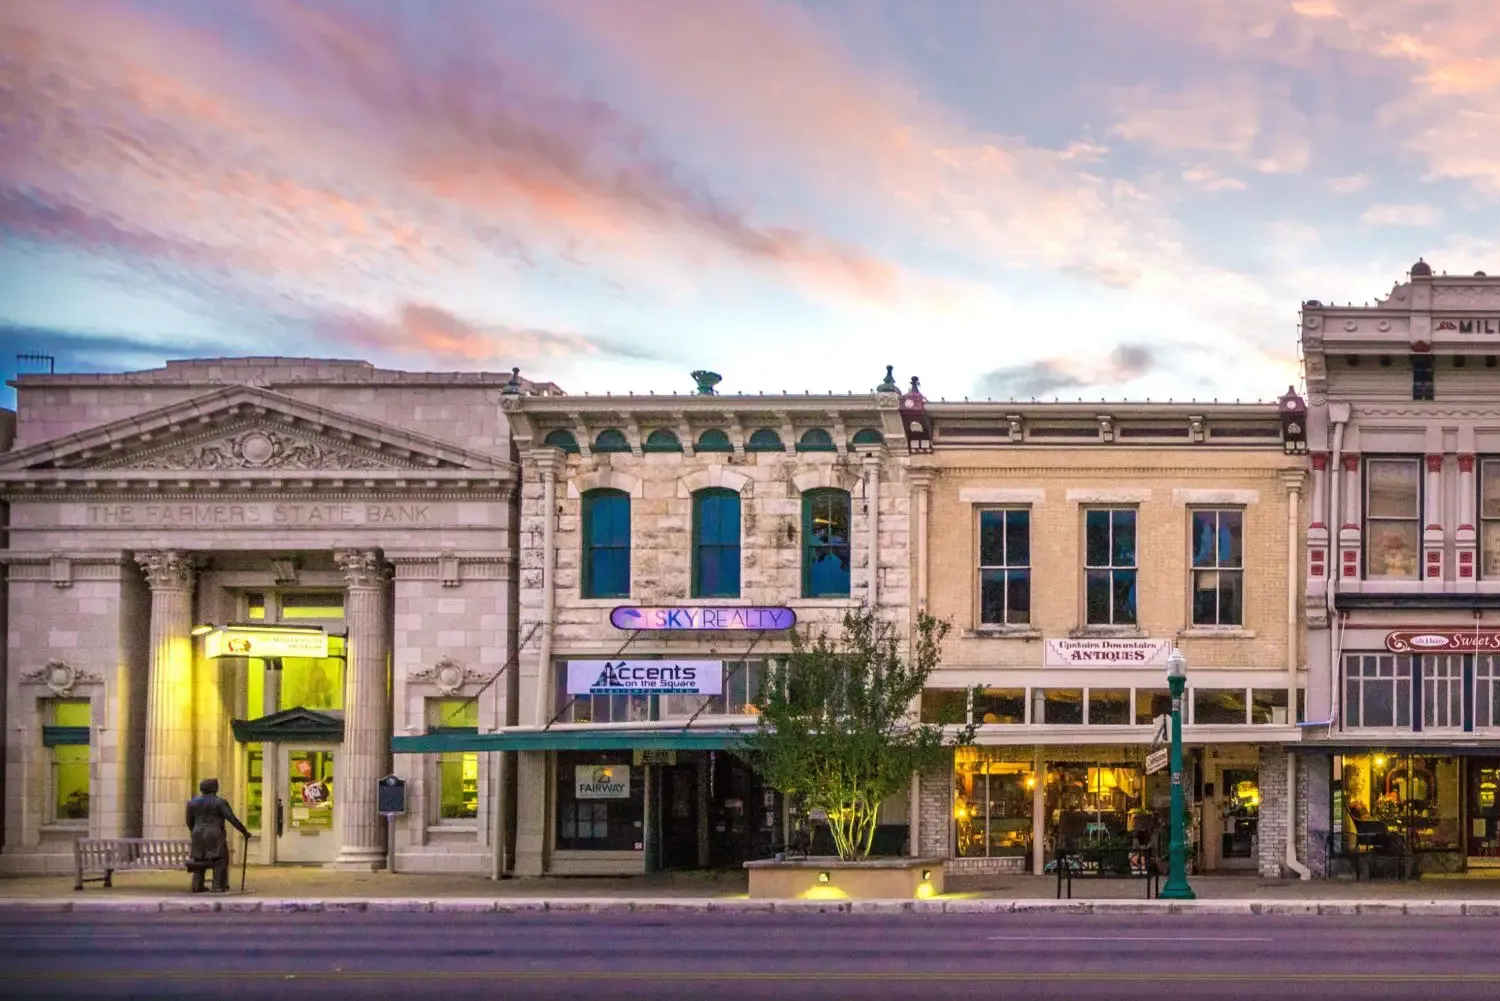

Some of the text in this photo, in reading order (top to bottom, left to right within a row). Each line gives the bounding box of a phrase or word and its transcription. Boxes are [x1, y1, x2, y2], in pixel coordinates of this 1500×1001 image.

[87, 504, 430, 522] THE FARMERS STATE BANK
[1060, 641, 1157, 649] Upstairs Downstairs
[1449, 634, 1490, 648] Sweet
[1071, 650, 1145, 662] ANTIQUES
[660, 680, 696, 689] Square
[580, 784, 625, 793] FAIRWAY
